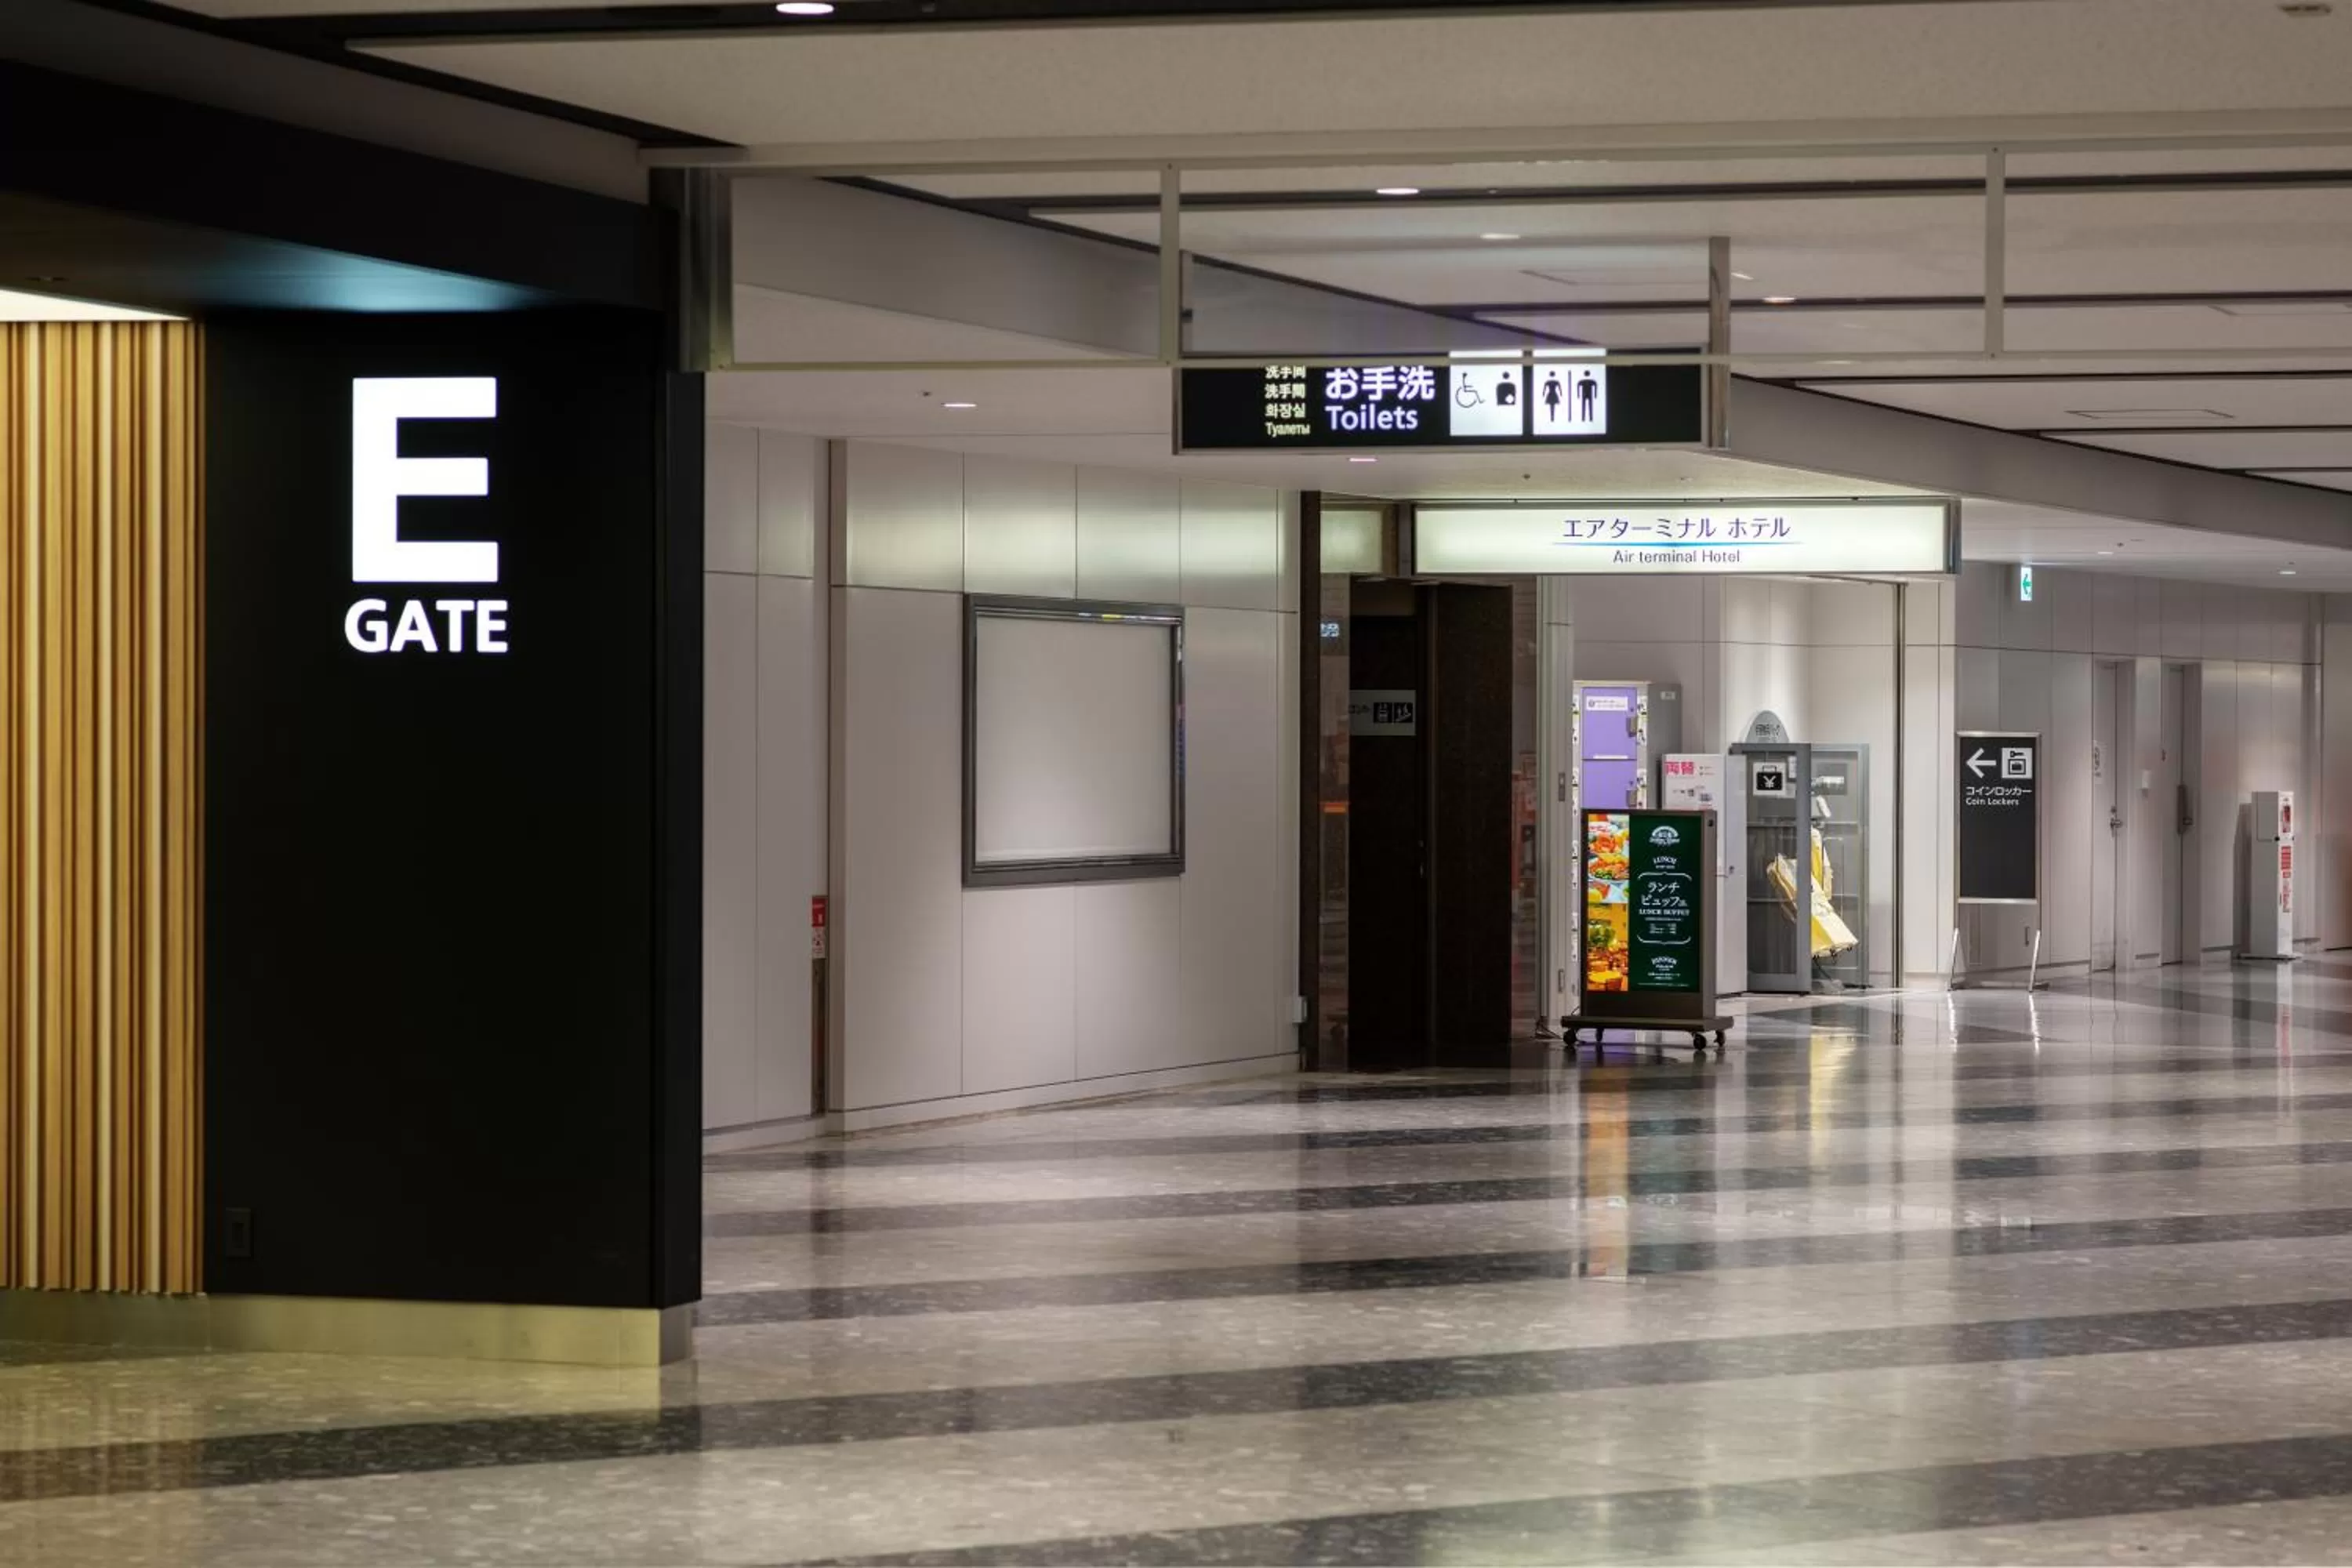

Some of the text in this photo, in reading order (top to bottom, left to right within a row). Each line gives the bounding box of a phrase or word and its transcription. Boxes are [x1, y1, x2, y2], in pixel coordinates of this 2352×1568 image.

[1325, 365, 1436, 401] お手洗
[1265, 402, 1305, 419] 화장실
[1324, 403, 1418, 430] Toilets
[1265, 422, 1310, 437] Туалеты
[351, 376, 499, 583] E
[1563, 517, 1791, 539] エアターミナル ホテル
[1612, 550, 1740, 563] Air terminal Hotel
[343, 597, 510, 653] GATE
[1965, 786, 2033, 796] コインロッカー
[1965, 797, 2020, 806] Coin Lockers
[1648, 880, 1680, 894] ランチ
